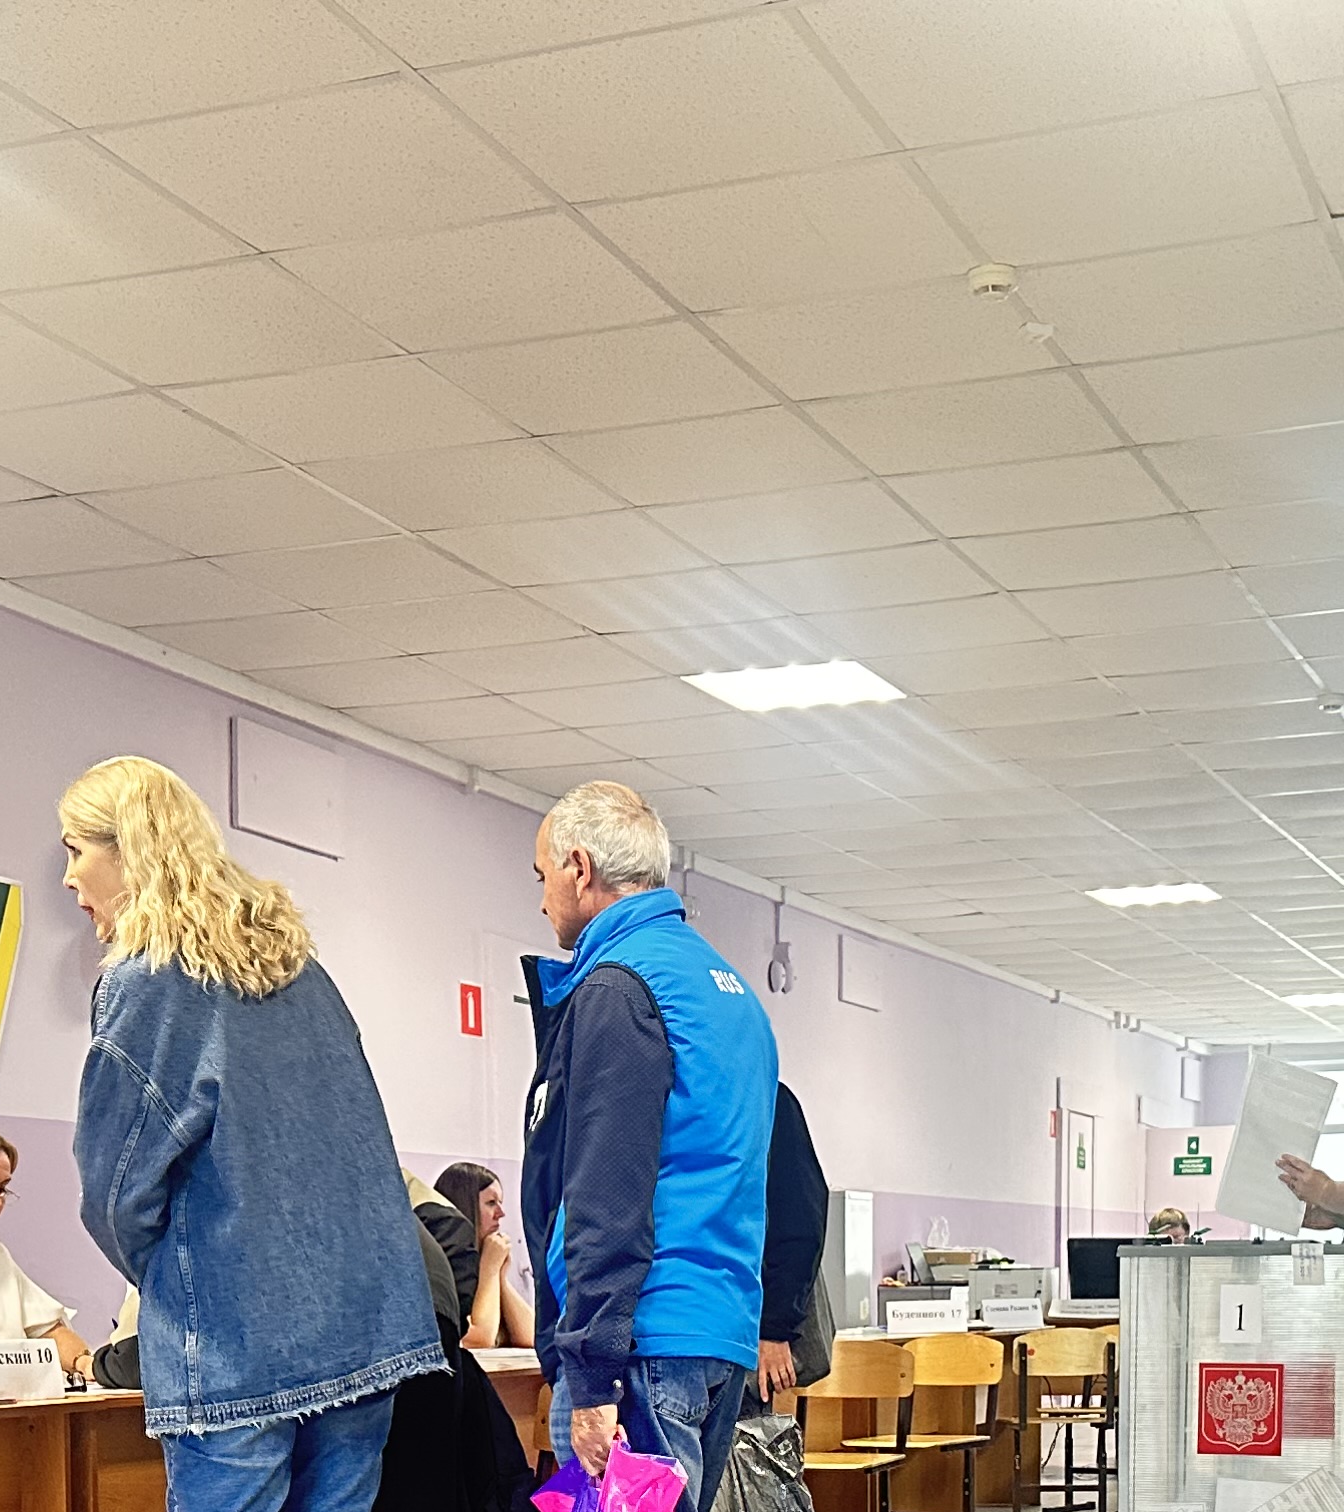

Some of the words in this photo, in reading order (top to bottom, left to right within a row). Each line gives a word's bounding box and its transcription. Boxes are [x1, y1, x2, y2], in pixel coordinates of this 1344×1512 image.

[951, 1309, 962, 1318] 17
[1235, 1304, 1246, 1331] 1
[37, 1348, 53, 1363] 10
